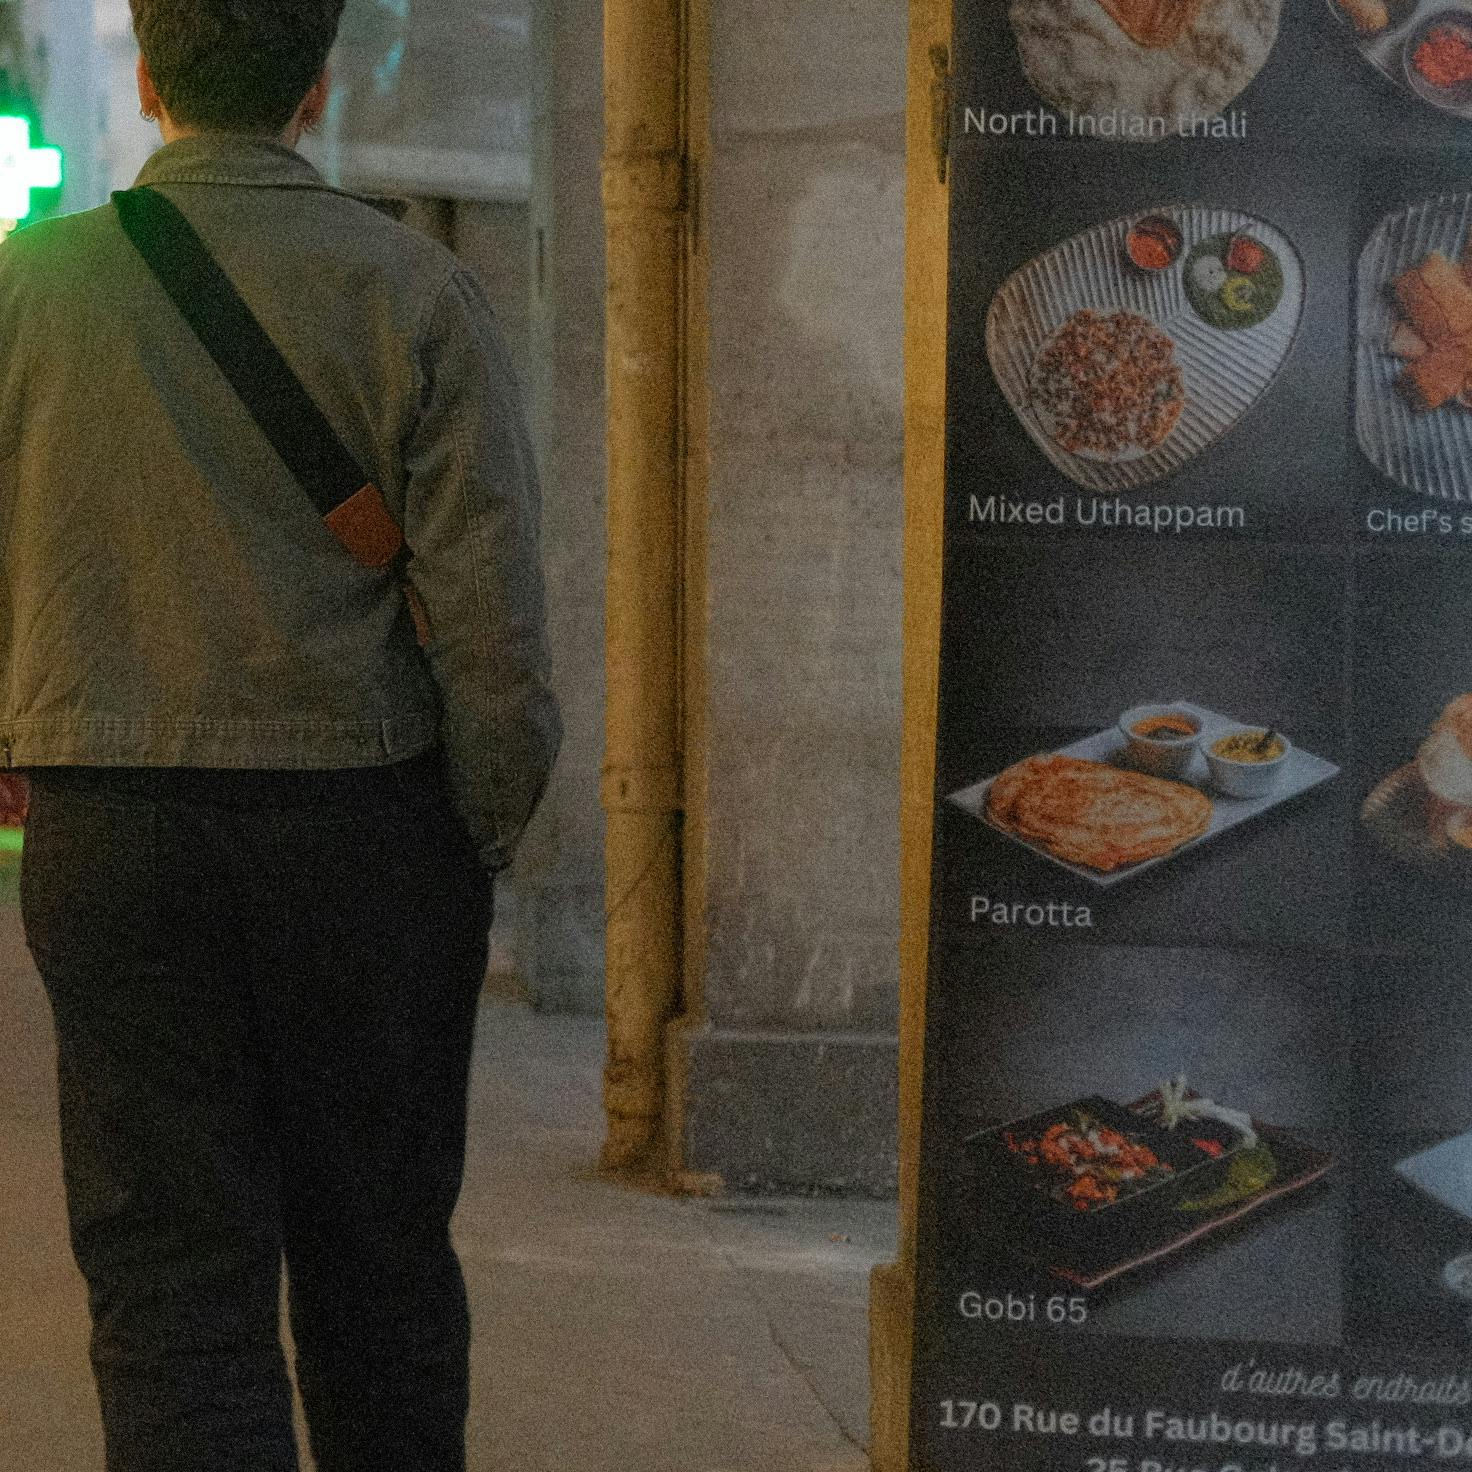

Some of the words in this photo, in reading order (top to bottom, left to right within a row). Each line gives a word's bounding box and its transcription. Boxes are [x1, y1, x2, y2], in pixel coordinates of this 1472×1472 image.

[963, 107, 1056, 135] North
[1068, 109, 1165, 137] Indian
[1178, 111, 1247, 138] thali
[967, 494, 1064, 524] Mixed
[1075, 496, 1245, 533] Uthappam
[1366, 509, 1453, 534] Chef's
[971, 896, 1093, 926] Parotta
[960, 1291, 1035, 1321] Gobi
[1047, 1296, 1087, 1323] 65
[1220, 1357, 1340, 1397] d'autres
[939, 1399, 1002, 1430] 170
[1012, 1404, 1080, 1435] Rue
[1088, 1407, 1134, 1438] du
[1145, 1410, 1316, 1456] Faubourg
